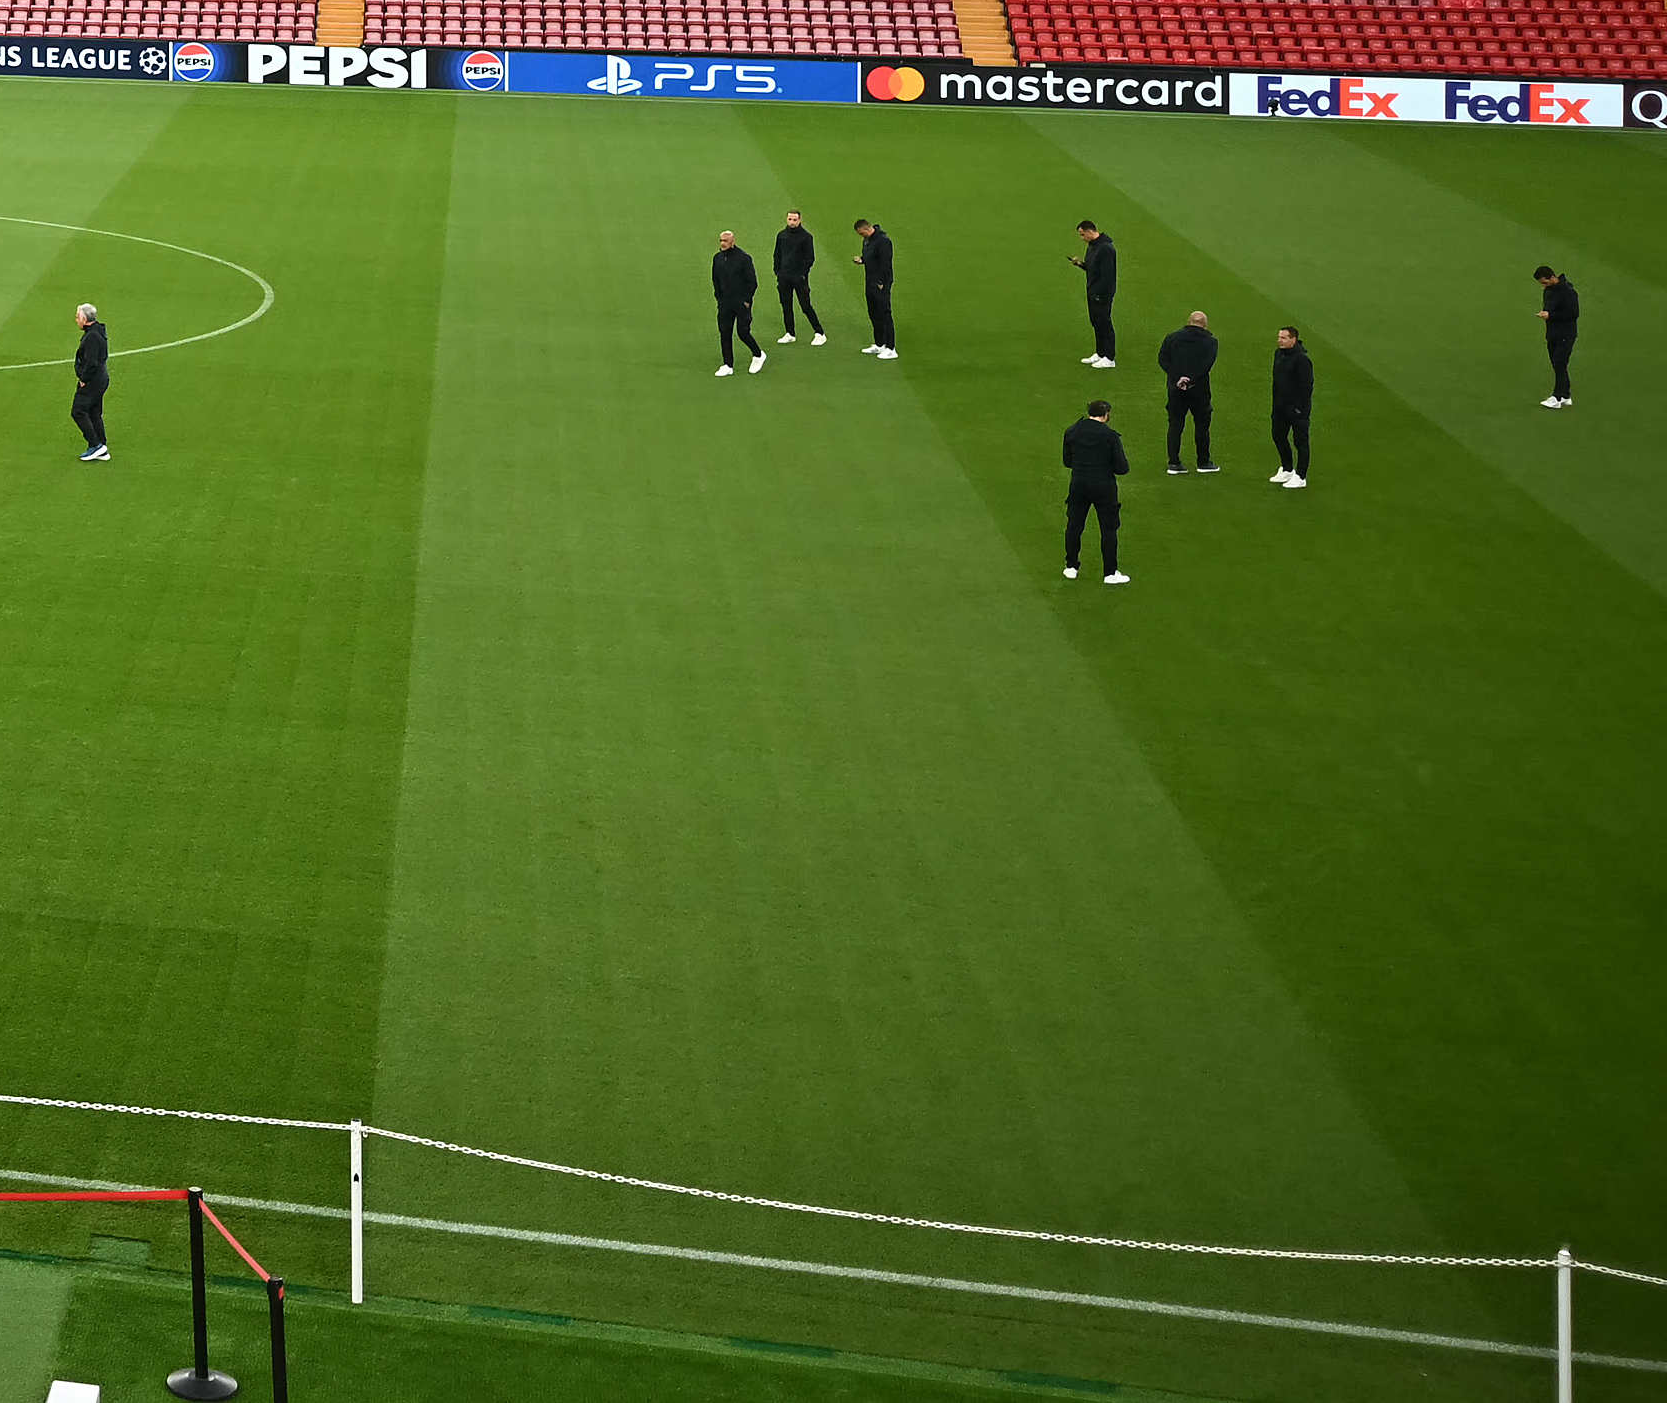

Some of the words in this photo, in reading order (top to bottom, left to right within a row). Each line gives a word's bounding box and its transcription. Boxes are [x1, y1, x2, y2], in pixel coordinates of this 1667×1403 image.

[31, 46, 132, 71] LEAGUE
[177, 56, 212, 66] PEPSI
[247, 44, 427, 89] PEPSI
[465, 65, 501, 75] PEPSI
[654, 64, 776, 93] PS5
[940, 71, 1223, 108] mastercard
[1257, 75, 1400, 117] FedEx
[1445, 81, 1592, 125] FedEx
